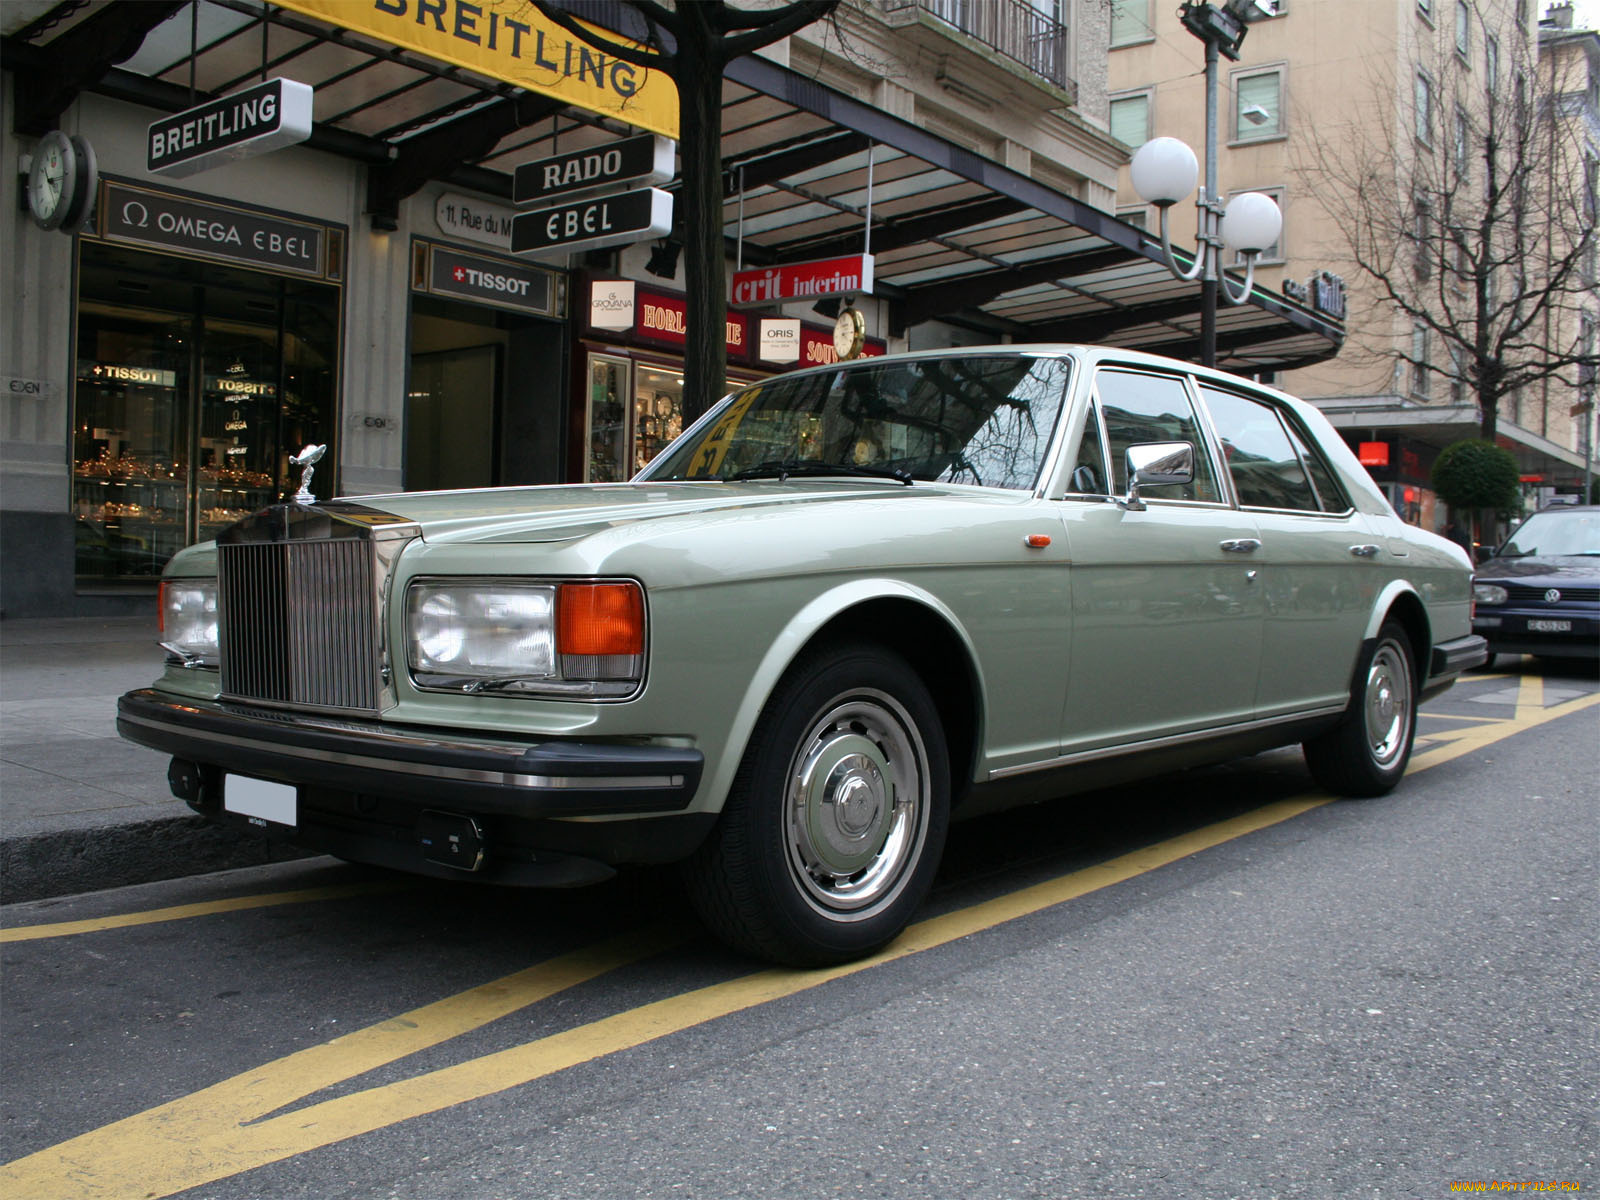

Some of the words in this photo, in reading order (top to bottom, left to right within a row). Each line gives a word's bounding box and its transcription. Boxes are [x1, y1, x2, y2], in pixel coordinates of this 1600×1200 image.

[152, 94, 278, 160] BREITLING
[542, 150, 622, 190] RADO
[158, 212, 242, 246] OMEGA
[253, 231, 310, 259] EBEL
[461, 207, 482, 230] Rue
[485, 214, 498, 234] du
[501, 217, 511, 237] M
[546, 203, 612, 240] EBEL
[465, 268, 530, 296] TISSOT
[735, 269, 783, 303] crit
[767, 329, 794, 338] ORIS
[104, 365, 158, 383] TISSOT
